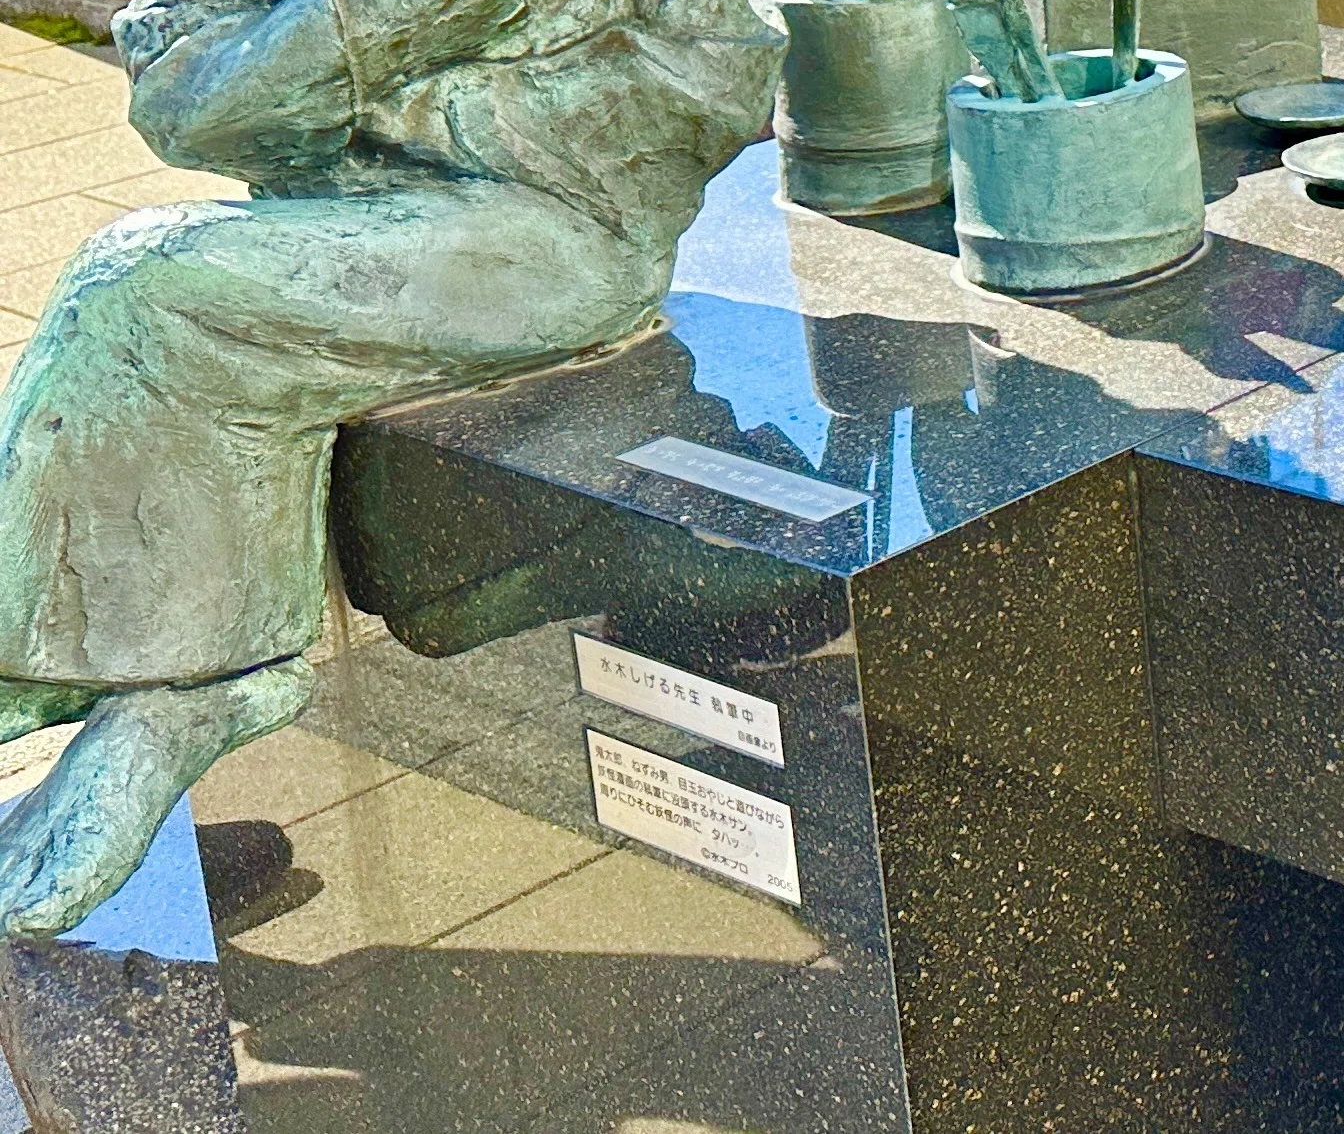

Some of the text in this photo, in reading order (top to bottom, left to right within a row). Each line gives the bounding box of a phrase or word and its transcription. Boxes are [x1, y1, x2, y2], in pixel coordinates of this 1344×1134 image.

[599, 656, 701, 706] 水木しげる先生
[767, 873, 794, 893] 2005
